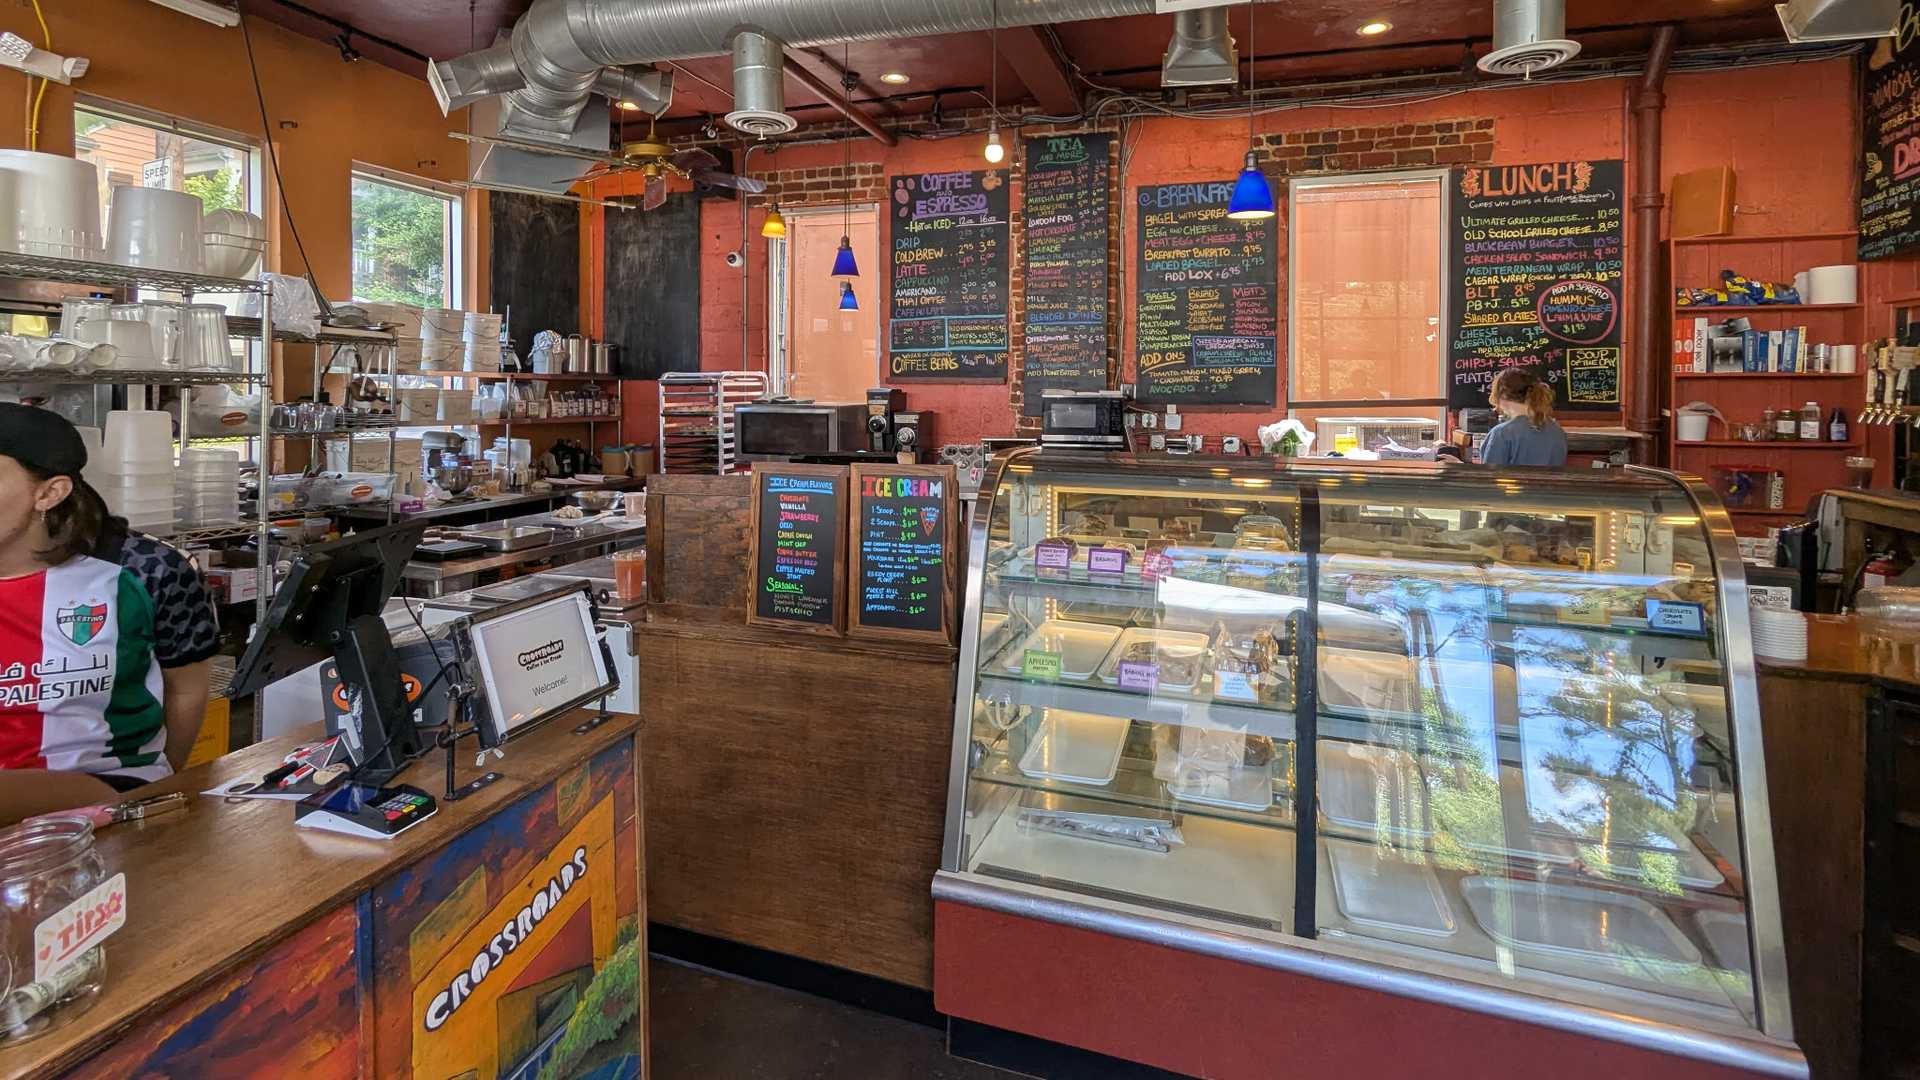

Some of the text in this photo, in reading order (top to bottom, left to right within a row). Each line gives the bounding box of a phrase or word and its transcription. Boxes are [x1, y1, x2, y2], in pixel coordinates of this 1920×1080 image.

[1047, 137, 1085, 152] TEA
[1057, 150, 1083, 159] MORE
[145, 165, 169, 179] SPEED
[921, 171, 973, 193] COFFEE
[1483, 163, 1573, 196] LUNCH
[1028, 193, 1074, 204] MATCHA LATTE
[1157, 183, 1236, 208] BREAKFAS
[916, 194, 987, 215] ESPRESSO
[1028, 216, 1055, 228] LONDON
[1145, 212, 1178, 226] BAGEL
[1197, 209, 1228, 220] SPREA
[1461, 215, 1578, 228] ULTIMATE GRILLED CHEESE
[1029, 228, 1043, 238] HOT
[1146, 226, 1168, 238] EGG
[1183, 225, 1218, 235] CHEESE
[1464, 225, 1592, 240] OLD SCHOOL GRILLED CHEESE
[896, 237, 920, 250] DRIP
[1029, 244, 1061, 254] LIMEADE
[1144, 238, 1170, 249] MEAT
[1172, 237, 1193, 247] EGG
[1465, 238, 1577, 253] BLACK BEAN BURGER
[895, 247, 944, 264] COLD BREW
[1144, 247, 1231, 261] BREAKFAST BURRITO
[1464, 249, 1587, 265] CHICKEN SALAD SANDWICH
[896, 264, 927, 279] LATTE
[1146, 258, 1222, 272] LOADED BAGEL
[1466, 262, 1584, 275] MEDITERRANEAN WRAP
[1165, 270, 1213, 281] ADD LOX
[1465, 274, 1527, 286] CAESAR WRAP
[895, 276, 949, 289] CAPPUCCINO
[895, 287, 937, 297] AMERICANO
[1144, 292, 1177, 301] BAGELS
[1188, 289, 1220, 300] BREADS
[1232, 287, 1267, 299] MEATS
[1465, 286, 1499, 300] BLT
[1552, 286, 1568, 296] ADD
[1576, 283, 1609, 300] SPREAD
[895, 296, 946, 307] THAI COFFEE
[1550, 295, 1595, 305] HUMMUS
[1543, 305, 1578, 314] PIMENTO
[1030, 312, 1102, 322] BLENDED DRINKS
[1464, 311, 1537, 324] SHARED PLATES
[1546, 313, 1604, 322] LAHMAJUNE
[1460, 327, 1498, 339] CHEESE
[1454, 336, 1514, 349] QUESADILLA
[1140, 351, 1185, 367] ADD ONS
[1455, 355, 1542, 369] CHIPS SALSA
[1576, 350, 1609, 361] SOUP
[1599, 357, 1617, 367] DAY
[892, 357, 959, 374] COFFEE BEANS
[1149, 384, 1195, 394] AVOCADO
[769, 477, 833, 490] ICE CREAM FLAVORS
[862, 476, 942, 499] ICE CREAM
[779, 494, 809, 503] CHOCOLATE
[780, 503, 806, 511] VANILLA
[780, 511, 819, 523] STRAWBERRY
[779, 521, 793, 529] OREO
[777, 530, 812, 540] COOKIE DOUGH
[795, 549, 817, 558] BUTTER
[776, 557, 803, 565] ESPRESSO
[774, 606, 813, 617] PISTACHIO
[60, 615, 104, 624] PALESTINO
[0, 674, 113, 707] PALESTINE
[532, 674, 569, 697] Welcome!
[425, 846, 587, 1031] CROSSROADS
